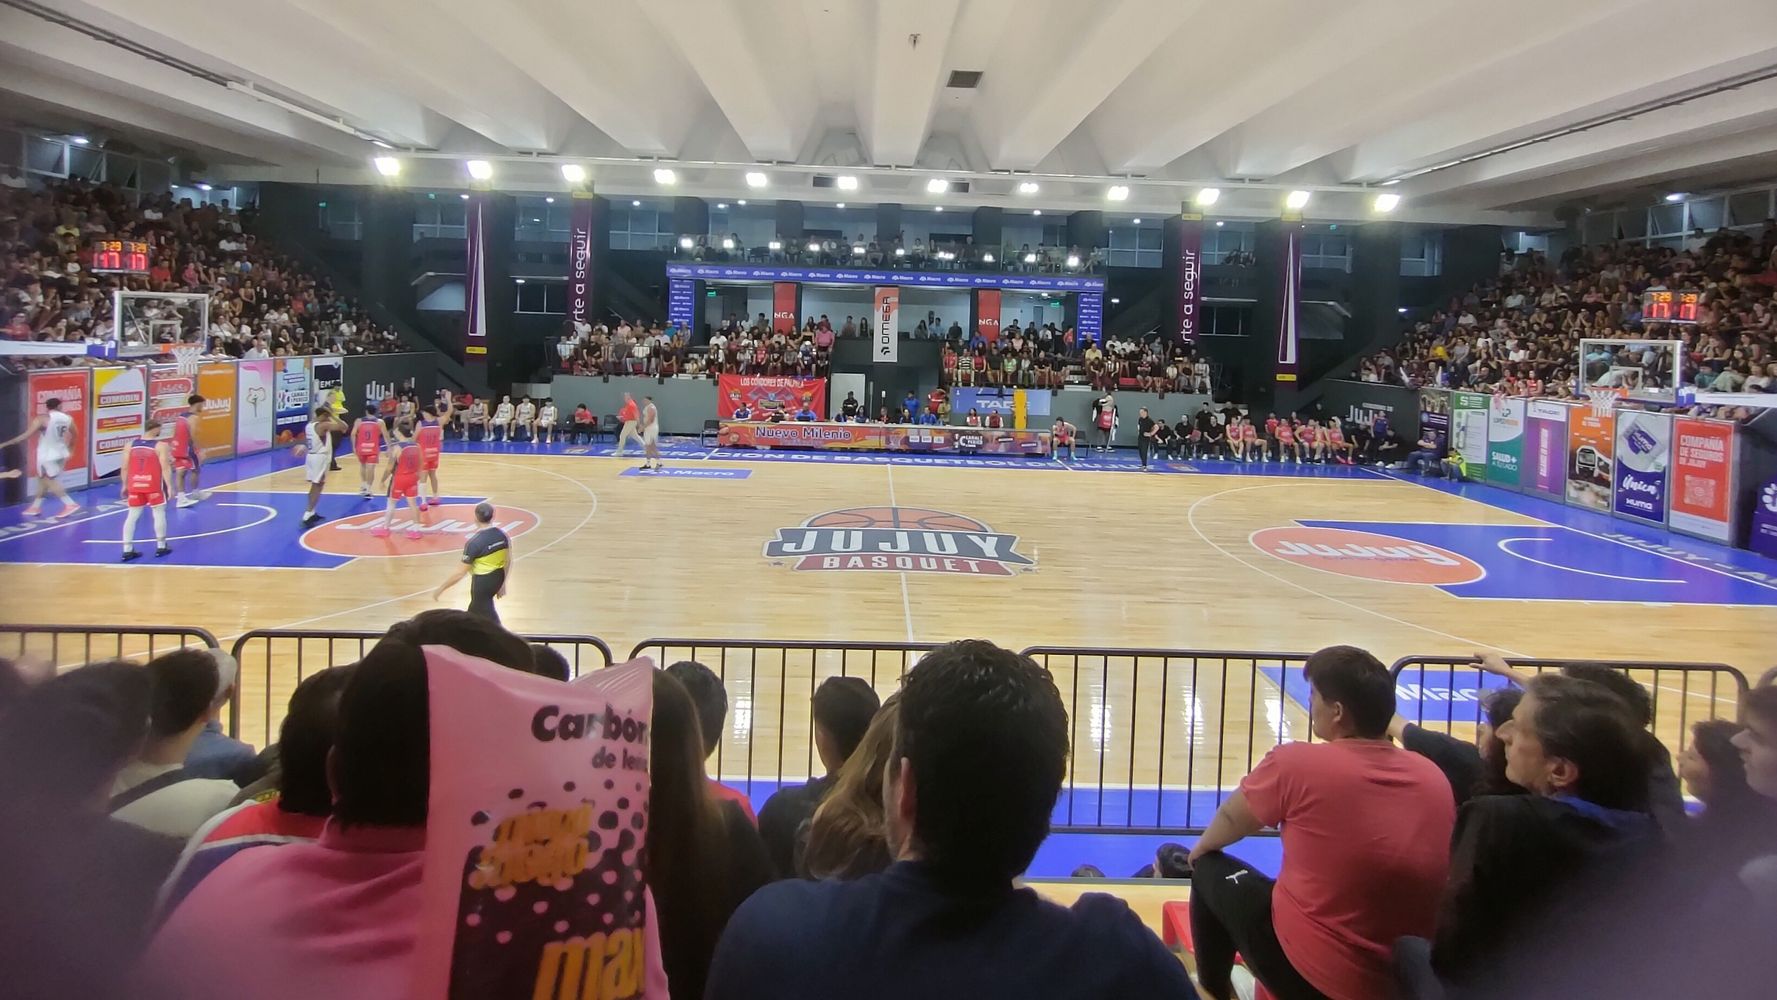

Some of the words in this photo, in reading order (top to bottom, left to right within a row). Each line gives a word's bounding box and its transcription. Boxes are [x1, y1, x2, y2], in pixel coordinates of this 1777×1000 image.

[574, 228, 587, 279] seguir
[1182, 250, 1198, 300] seguir
[575, 284, 585, 295] a
[1183, 304, 1193, 315] a
[881, 296, 891, 345] OMEGA
[755, 426, 798, 438] Nuevo
[803, 426, 851, 440] Milenio
[834, 456, 1022, 467] BASQUETBOL
[782, 530, 998, 557] JUJUY
[822, 555, 979, 573] BASQUET
[1396, 683, 1480, 702] Mac
[591, 746, 616, 769] de
